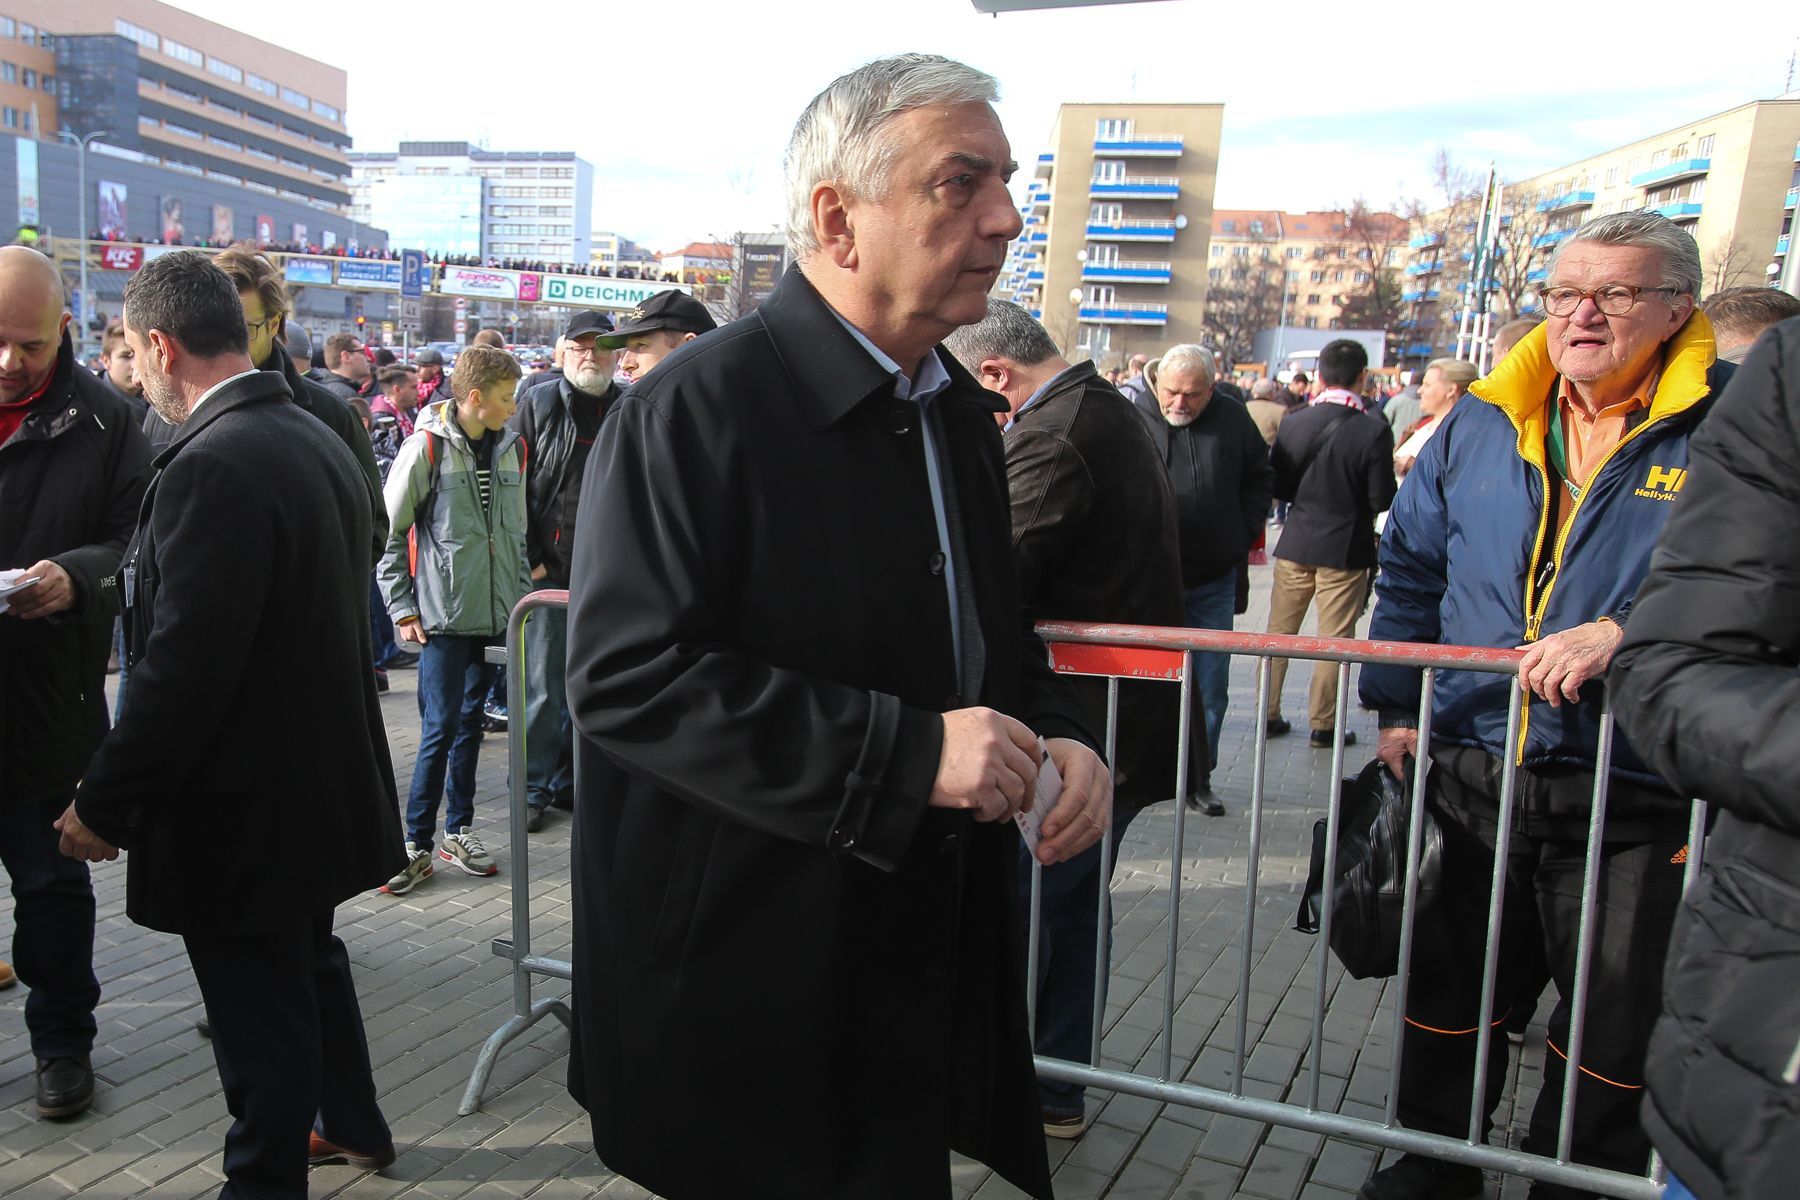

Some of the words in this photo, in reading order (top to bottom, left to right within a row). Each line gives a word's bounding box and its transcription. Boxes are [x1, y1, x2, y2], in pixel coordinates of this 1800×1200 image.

[106, 248, 136, 264] KFC
[405, 255, 419, 283] P
[572, 285, 655, 301] DEICHMA
[1634, 488, 1678, 502] HellyHa
